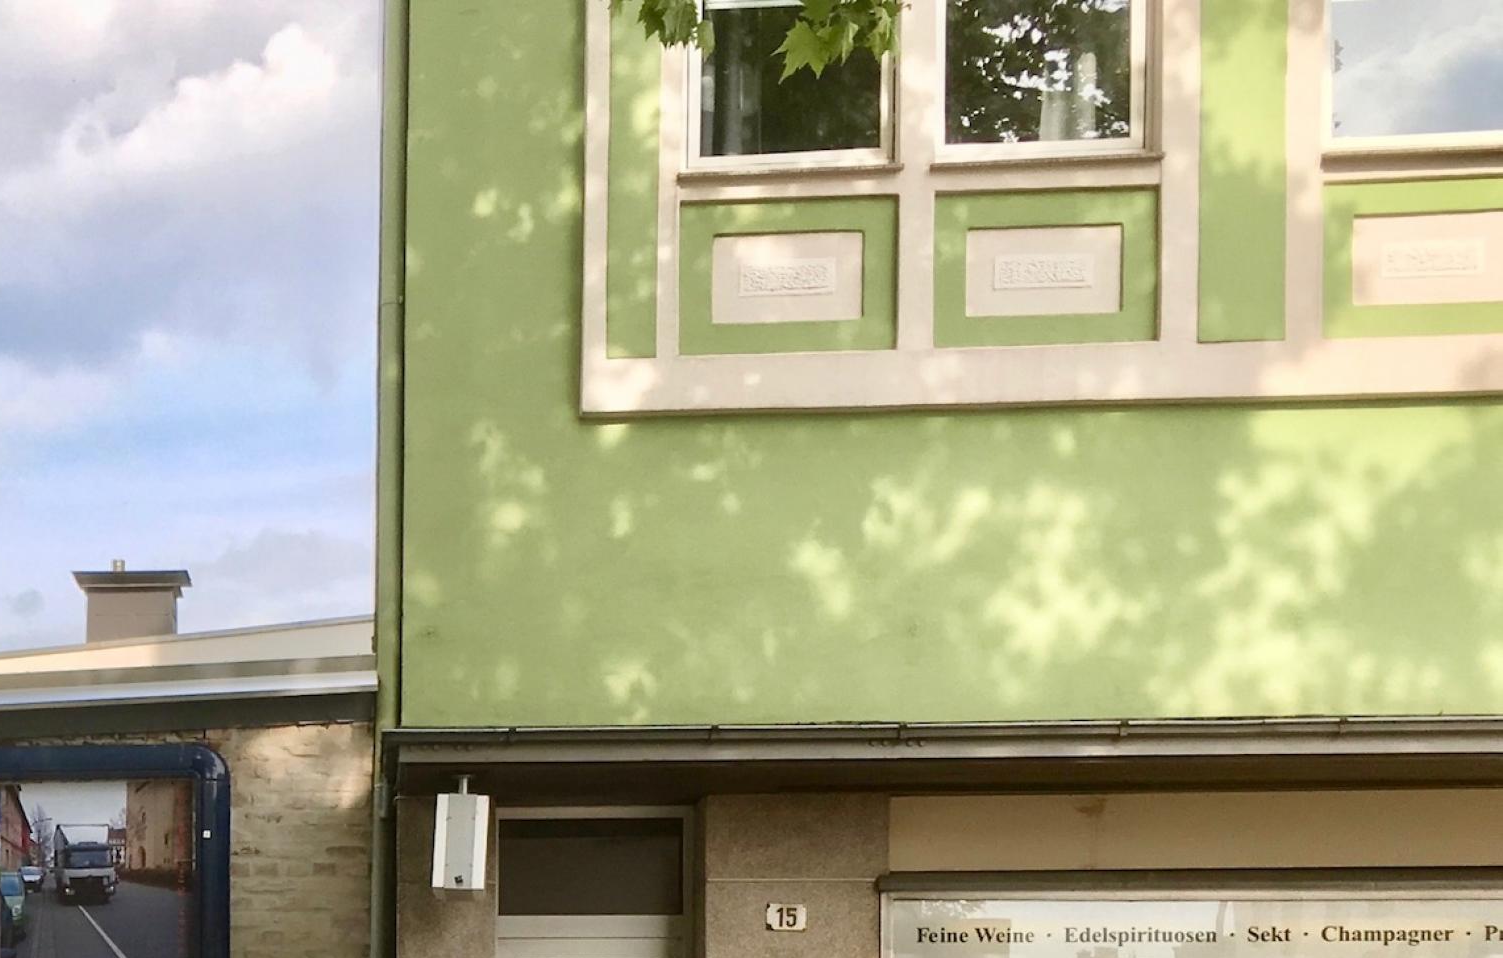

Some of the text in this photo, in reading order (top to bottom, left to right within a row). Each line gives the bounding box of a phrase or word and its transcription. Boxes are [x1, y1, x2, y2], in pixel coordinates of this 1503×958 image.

[776, 906, 797, 927] 15
[916, 927, 969, 943] Feine
[974, 927, 1035, 943] Weine
[1064, 926, 1217, 946] Edelspirituosen
[1247, 926, 1291, 943] Sekt
[1320, 925, 1454, 946] Champagner
